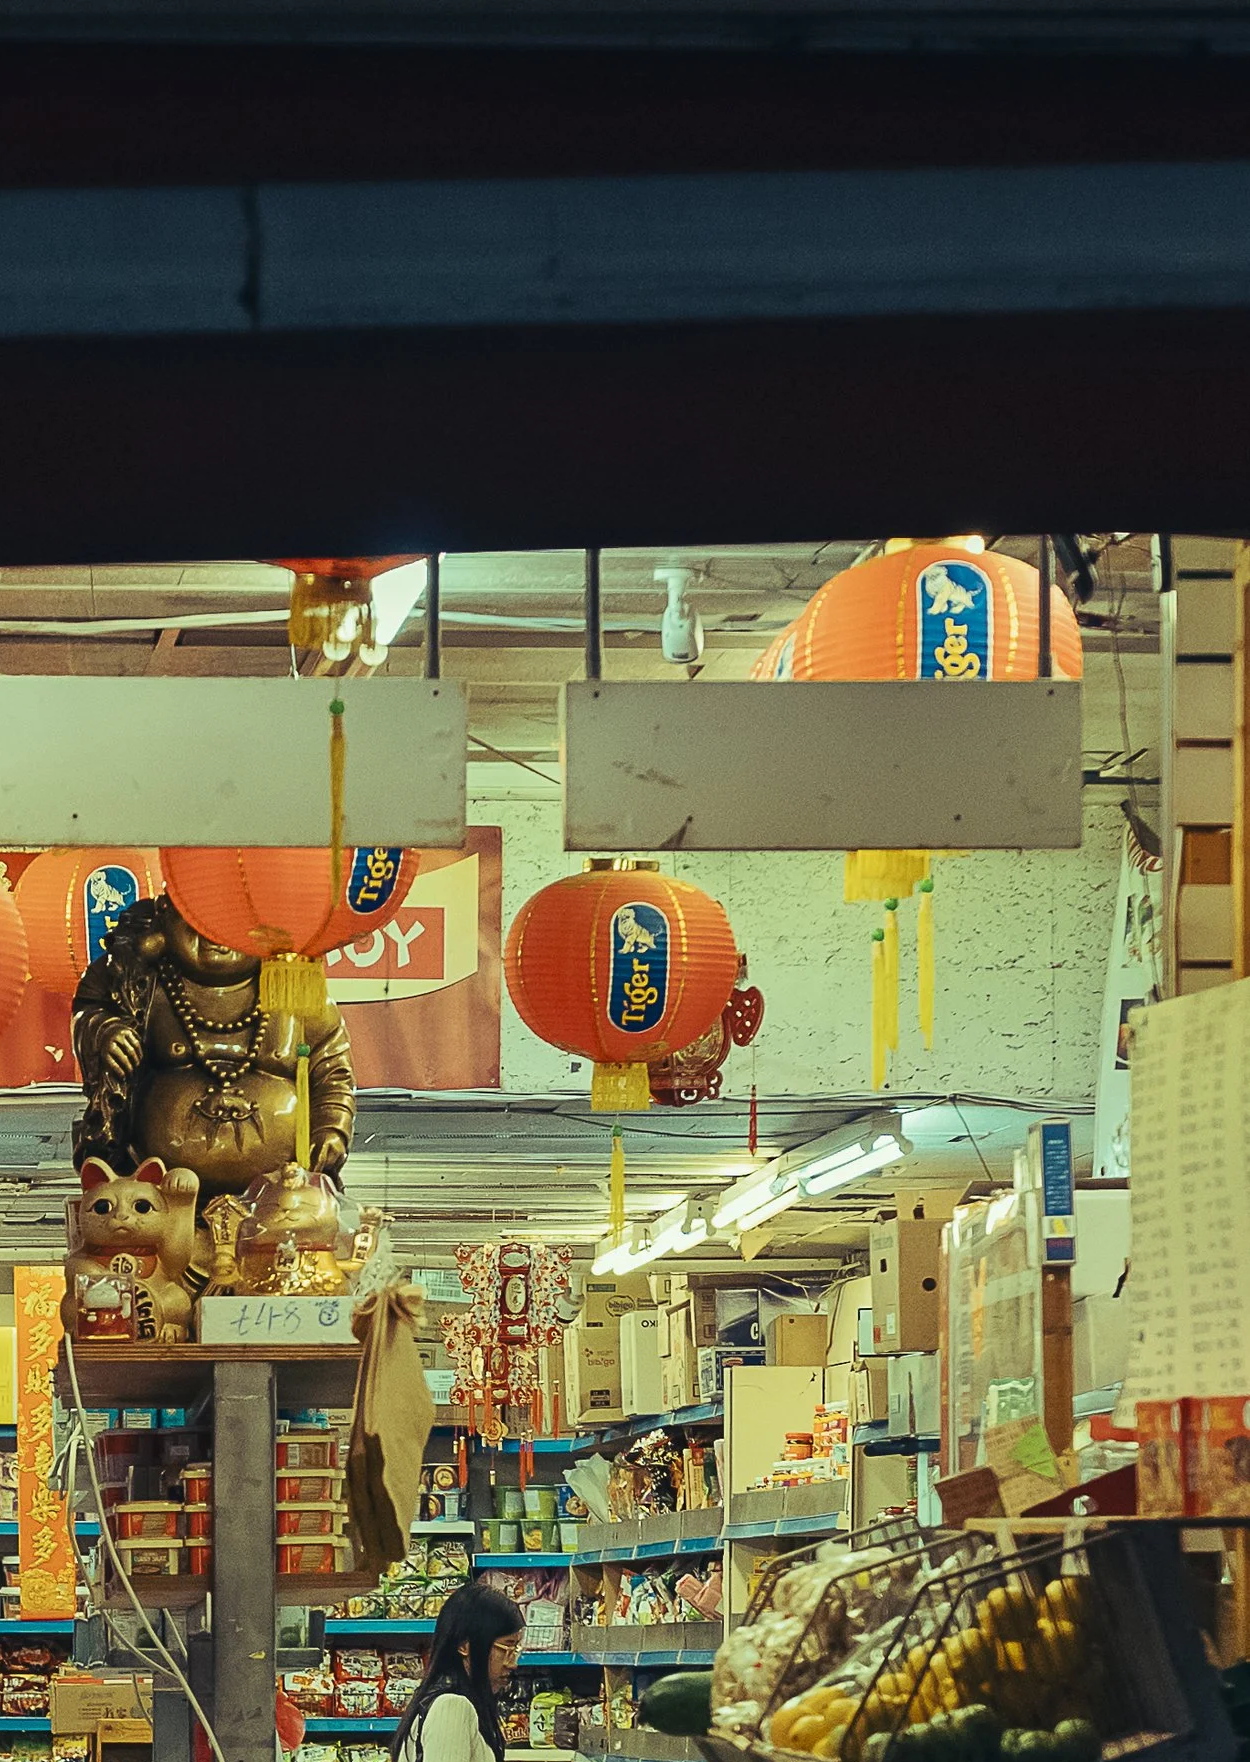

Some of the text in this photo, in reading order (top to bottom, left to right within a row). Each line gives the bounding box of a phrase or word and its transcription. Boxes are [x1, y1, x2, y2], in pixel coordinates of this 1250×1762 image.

[356, 847, 394, 905] Tige
[325, 919, 425, 968] OY
[621, 958, 658, 1026] Tiger
